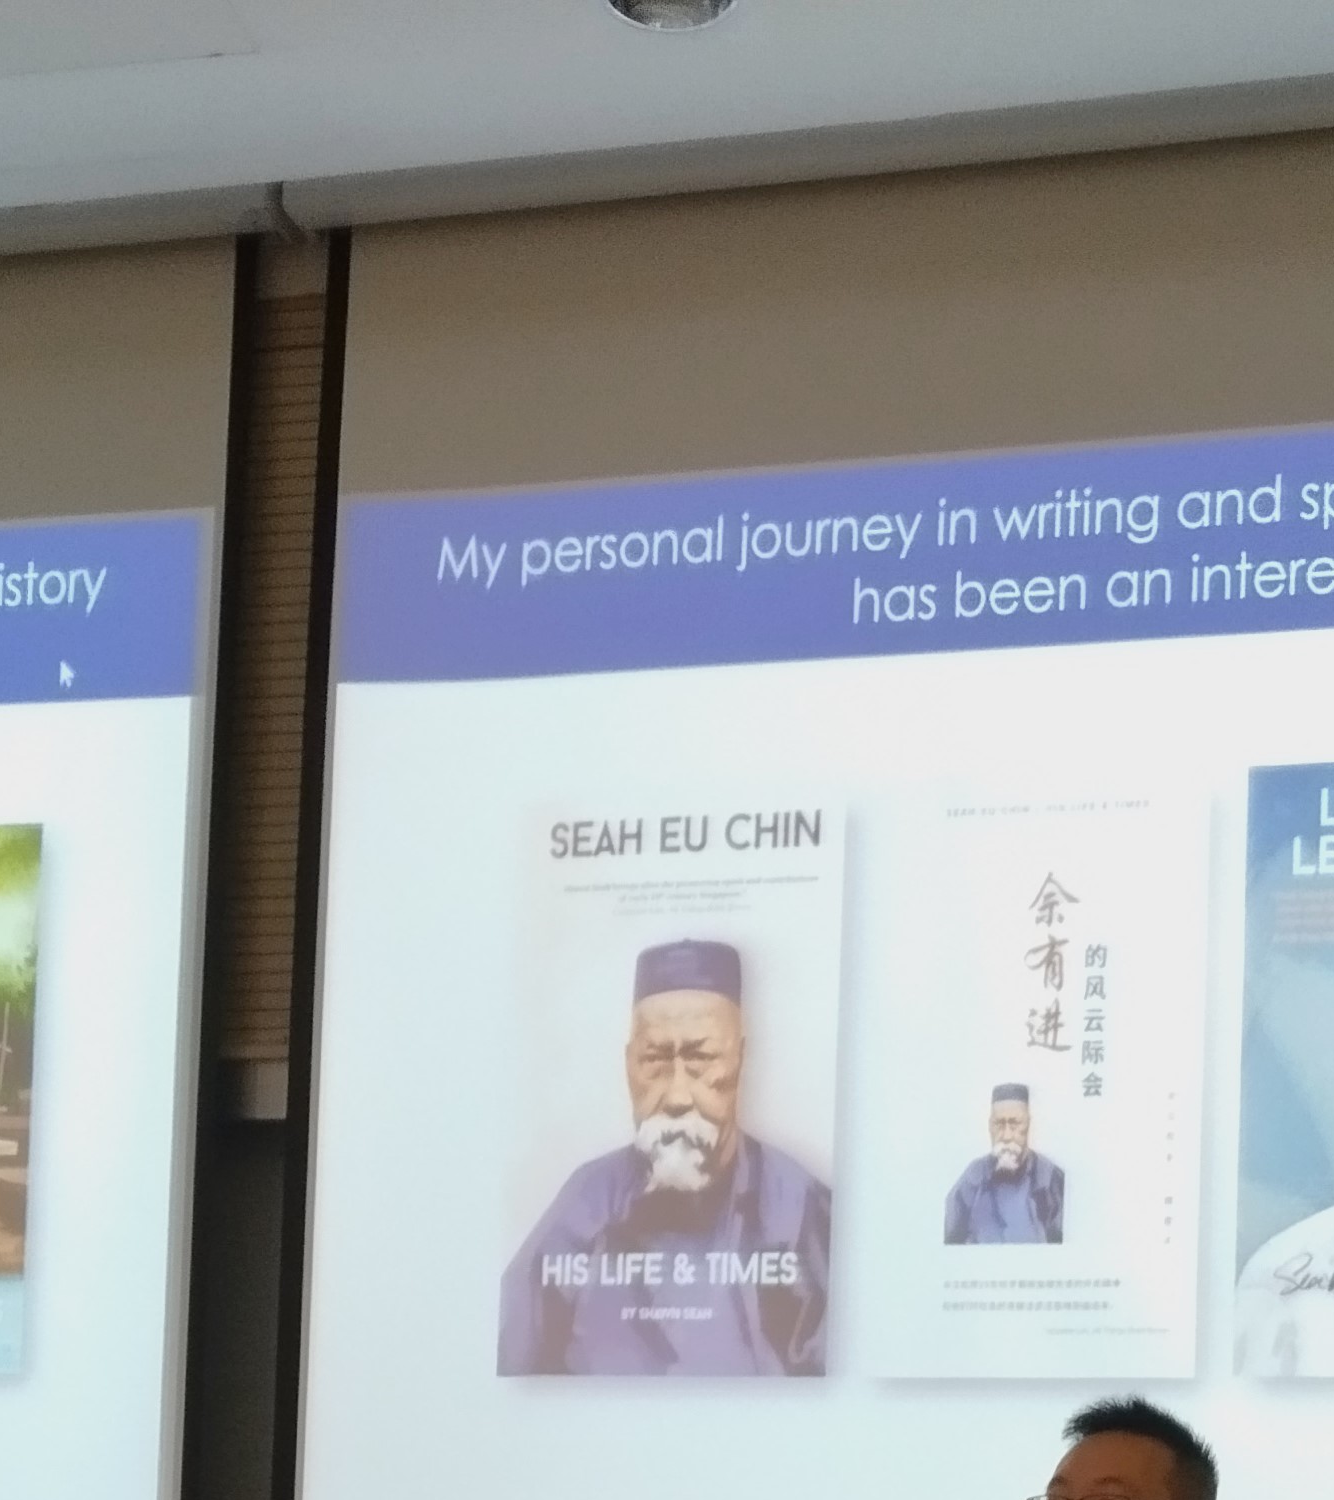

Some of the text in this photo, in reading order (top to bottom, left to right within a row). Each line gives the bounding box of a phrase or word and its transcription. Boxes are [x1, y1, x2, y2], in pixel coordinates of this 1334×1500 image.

[436, 536, 506, 590] My
[519, 516, 725, 588] personal
[737, 510, 923, 572] journey
[936, 497, 977, 546] in
[994, 487, 1160, 544] writing
[1177, 474, 1283, 529] and
[853, 578, 937, 625] has
[954, 571, 1088, 619] been
[1105, 565, 1173, 609] an
[550, 808, 822, 860] SEAH EU CHIN
[1080, 942, 1108, 1098] 的风云际会
[540, 1251, 800, 1287] HIS LIFE & TIMES
